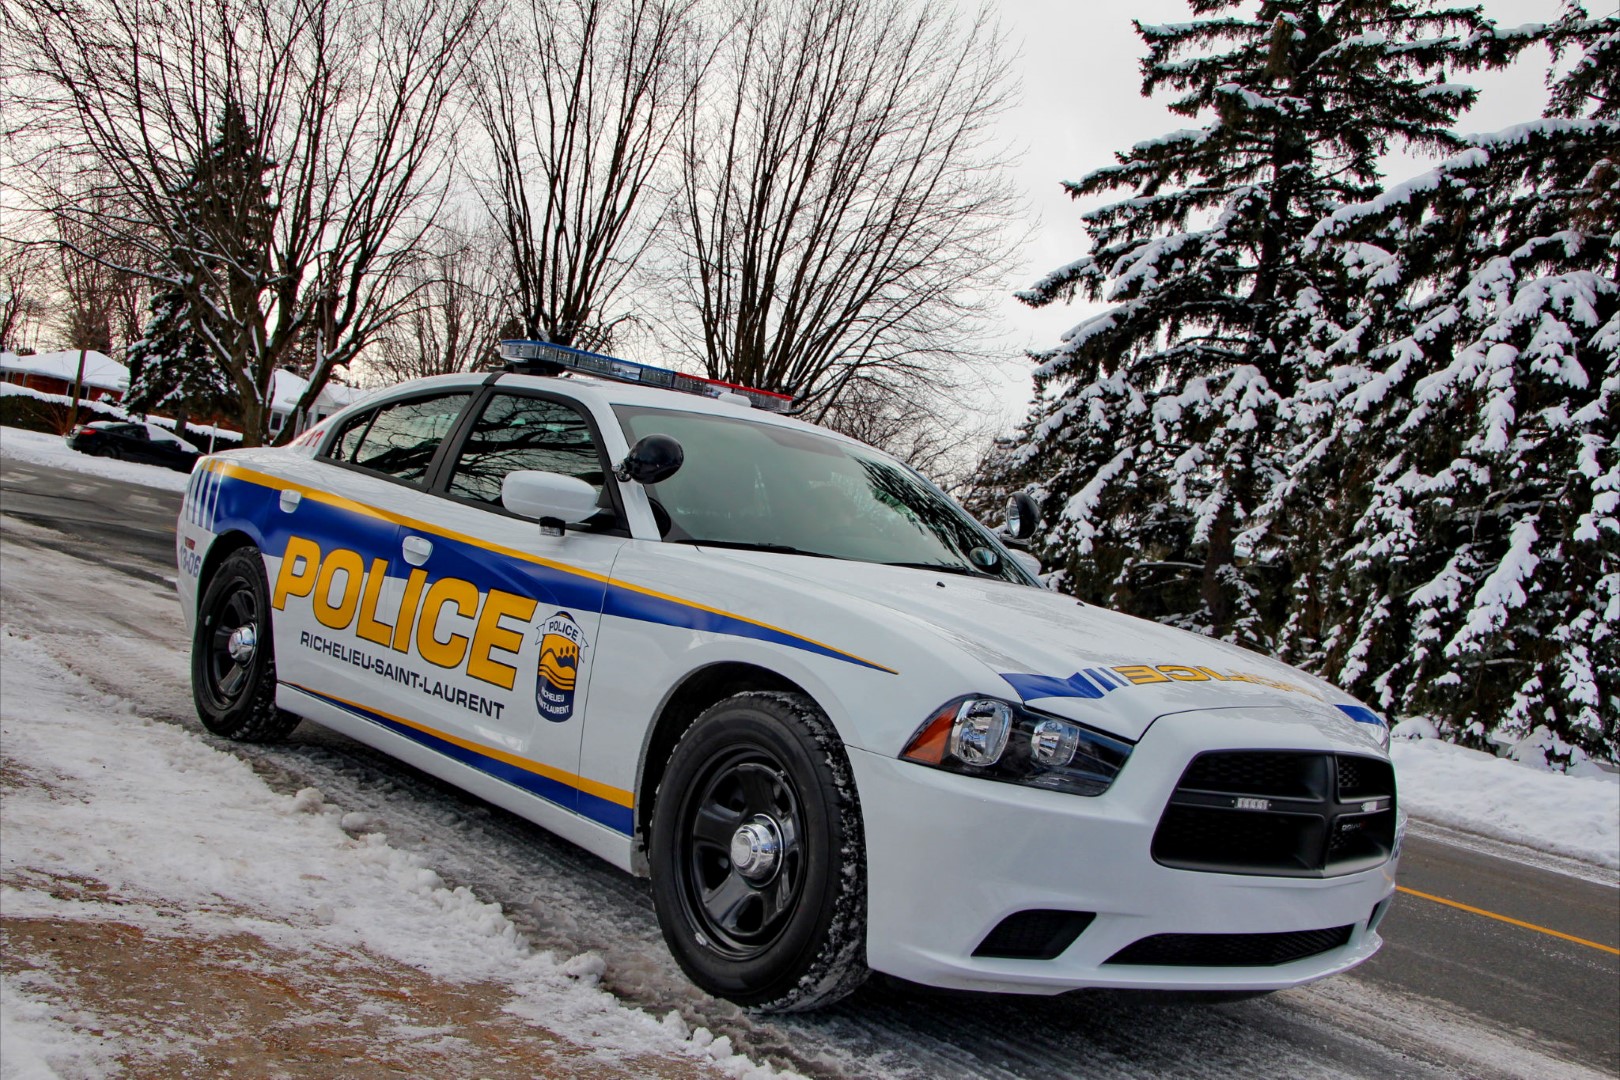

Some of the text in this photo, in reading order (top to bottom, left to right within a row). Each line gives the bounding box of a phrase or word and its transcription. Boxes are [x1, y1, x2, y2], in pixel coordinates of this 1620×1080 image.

[180, 545, 201, 578] 13-06
[272, 535, 538, 690] POLICE
[549, 620, 578, 640] POLICE
[300, 631, 504, 719] RICHELIEU-SAINT-LAURENT
